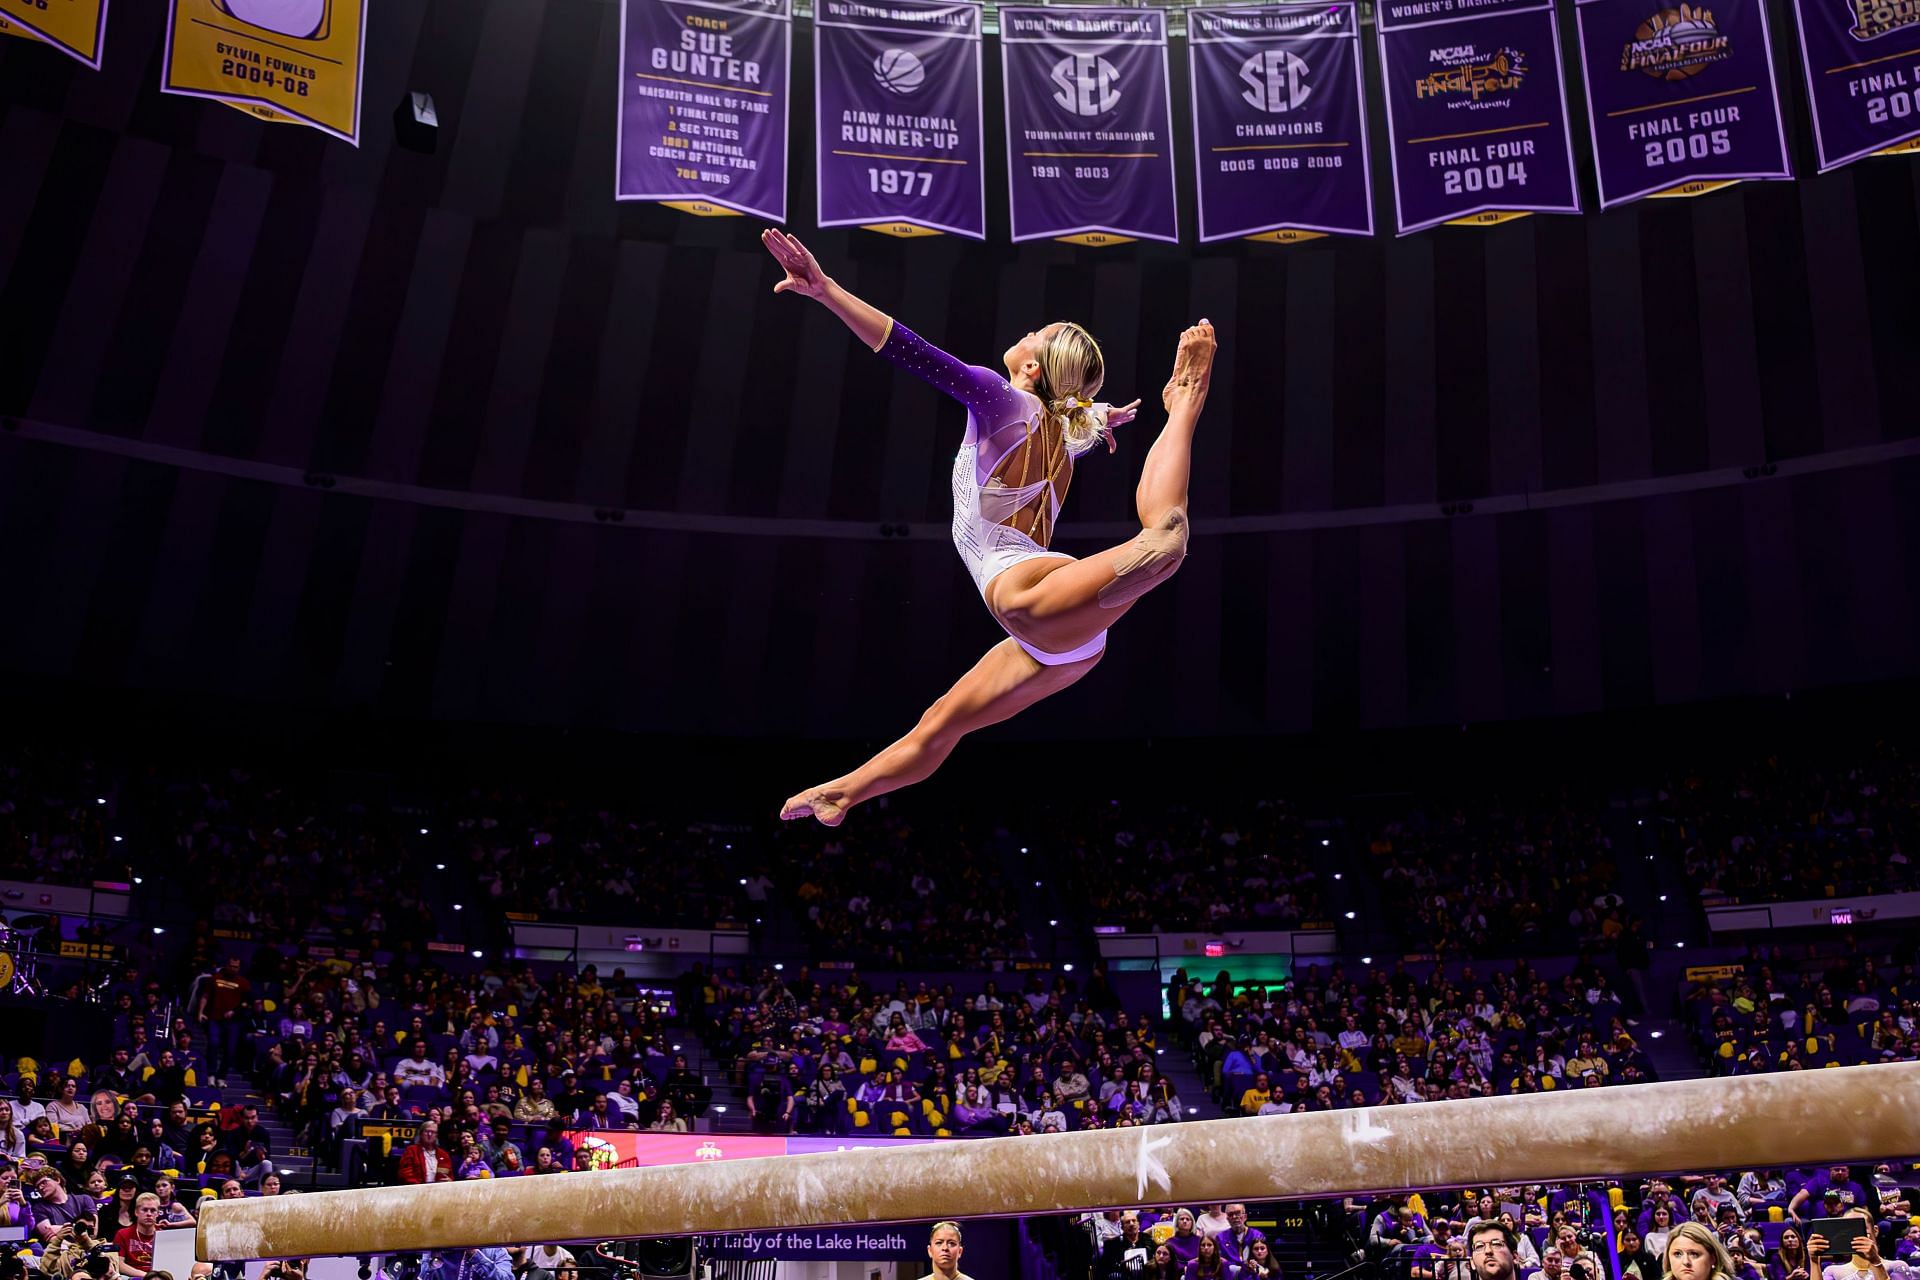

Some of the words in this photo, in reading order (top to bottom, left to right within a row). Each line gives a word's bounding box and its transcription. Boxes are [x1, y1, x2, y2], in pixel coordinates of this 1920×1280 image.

[686, 15, 729, 30] COACH
[1014, 19, 1073, 31] WOMEN'S
[1076, 20, 1153, 33] BASKETBALL
[1201, 17, 1261, 31] WOMEN'S
[680, 29, 734, 57] SUE
[1429, 45, 1475, 62] NCAA
[216, 42, 261, 64] SYLVIA
[265, 56, 316, 80] FOWLES
[651, 48, 761, 84] GUNTER
[222, 59, 309, 96] 2004-08
[1050, 53, 1121, 116] SEC
[1239, 50, 1312, 113] SEC
[1849, 70, 1907, 97] FINAL
[639, 85, 693, 103] NAISMITH
[695, 93, 721, 107] HALL
[724, 98, 738, 109] OF
[740, 100, 769, 114] FAME
[676, 106, 708, 120] FINAL
[710, 111, 740, 125] FOUR
[843, 110, 881, 126] AIAW
[886, 113, 958, 132] NATIONAL
[1628, 116, 1683, 140] FINAL
[1689, 106, 1741, 129] FOUR
[679, 122, 701, 135] SEC
[703, 125, 740, 140] TITLES
[841, 124, 960, 150] RUNNER-UP
[1024, 130, 1092, 141] TOURNAMENT
[1095, 131, 1156, 142] CHAMPIONS
[1236, 121, 1324, 137] CHAMPIONS
[649, 145, 686, 161] COACH
[688, 151, 703, 163] OF
[705, 153, 726, 166] THE
[729, 157, 757, 171] YEAR
[691, 140, 745, 157] NATIONAL
[1428, 146, 1480, 167] FINAL
[1486, 139, 1535, 161] FOUR
[1644, 129, 1731, 168] 2005
[1031, 165, 1061, 178] 1991
[1075, 166, 1110, 179] 2003
[1220, 159, 1256, 173] 2005
[1264, 157, 1299, 171] 2006
[1307, 155, 1343, 169] 2008
[701, 171, 731, 185] WINS
[867, 168, 934, 197] 1977
[1443, 161, 1528, 195] 2004
[1284, 1217, 1304, 1228] 112
[724, 1232, 762, 1253] Lady
[765, 1232, 783, 1249] of
[786, 1232, 813, 1250] the
[816, 1233, 853, 1250] Lake
[856, 1233, 907, 1250] Health
